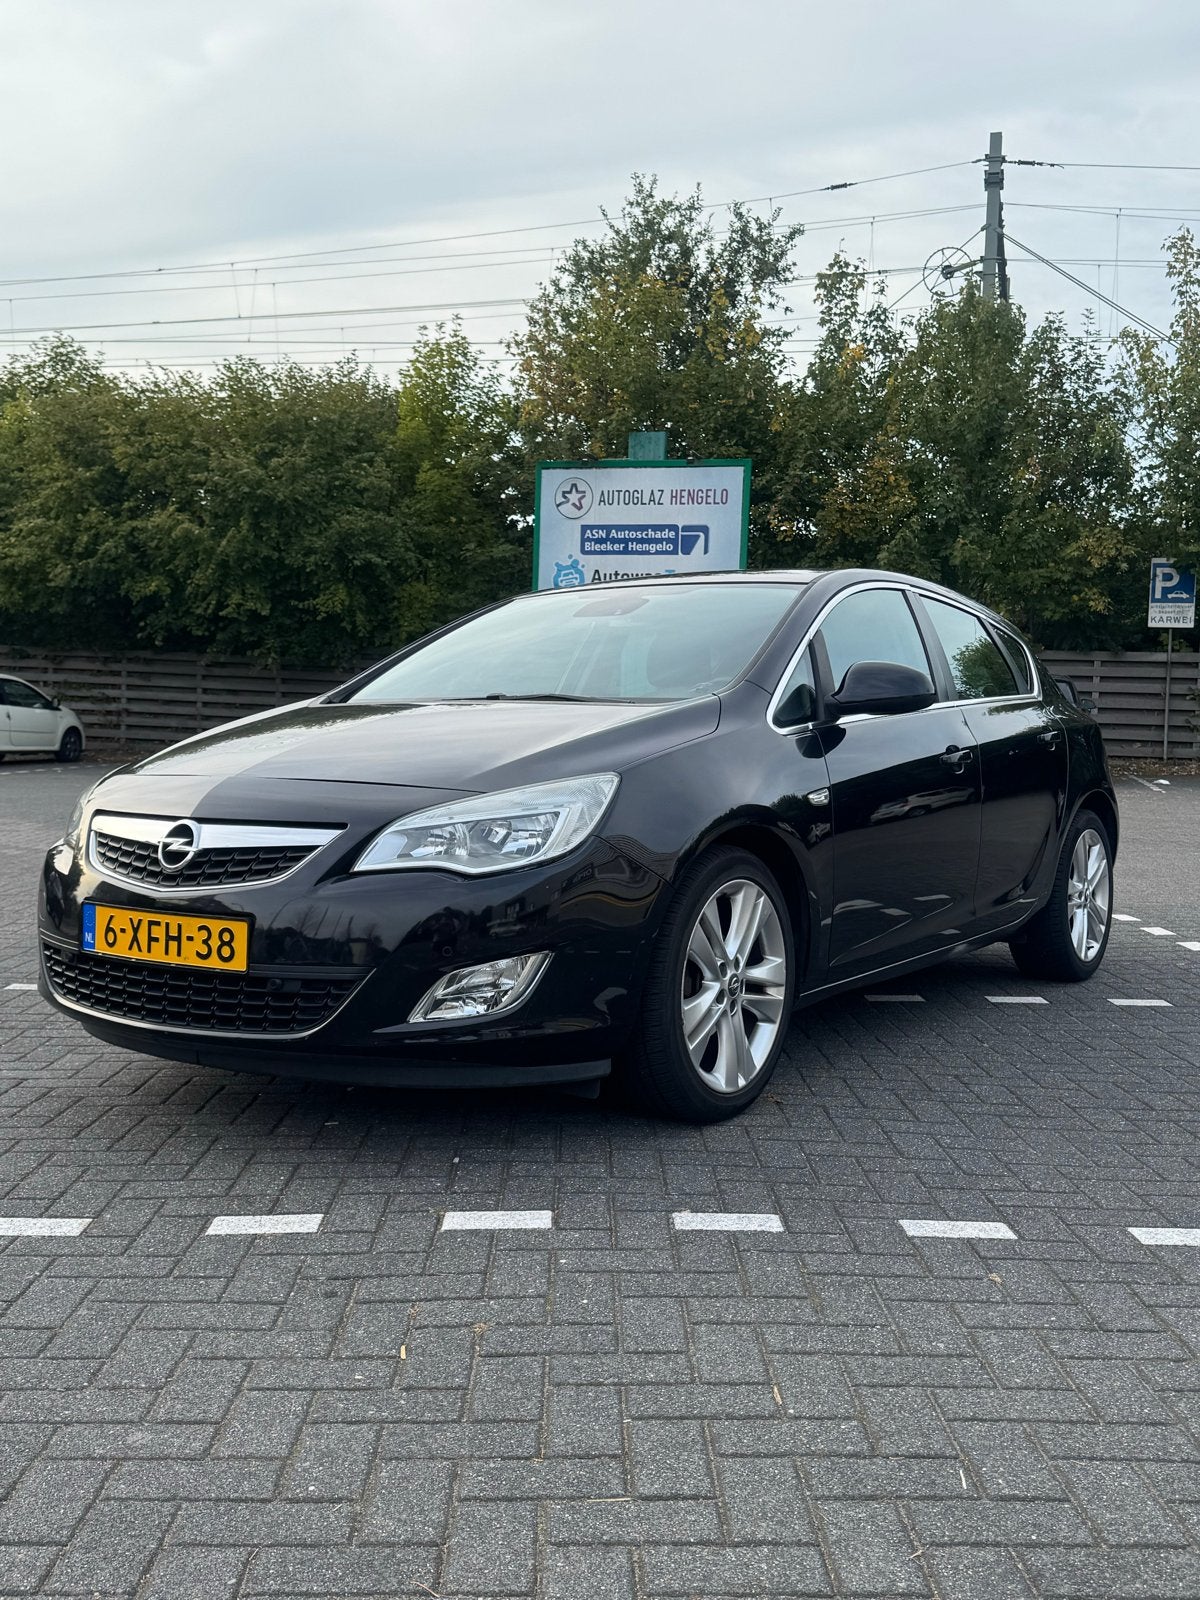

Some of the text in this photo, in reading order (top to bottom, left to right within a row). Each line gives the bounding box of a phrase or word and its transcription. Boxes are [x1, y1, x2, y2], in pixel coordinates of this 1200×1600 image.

[598, 488, 728, 506] AUTOGLAZ HENGELO
[584, 528, 676, 539] ASN Autoschade
[584, 541, 673, 554] Bleeker Hengelo
[1154, 567, 1180, 599] P
[1150, 616, 1192, 624] KARWEI
[85, 931, 95, 944] NL
[104, 914, 236, 963] 6-XFH-38
